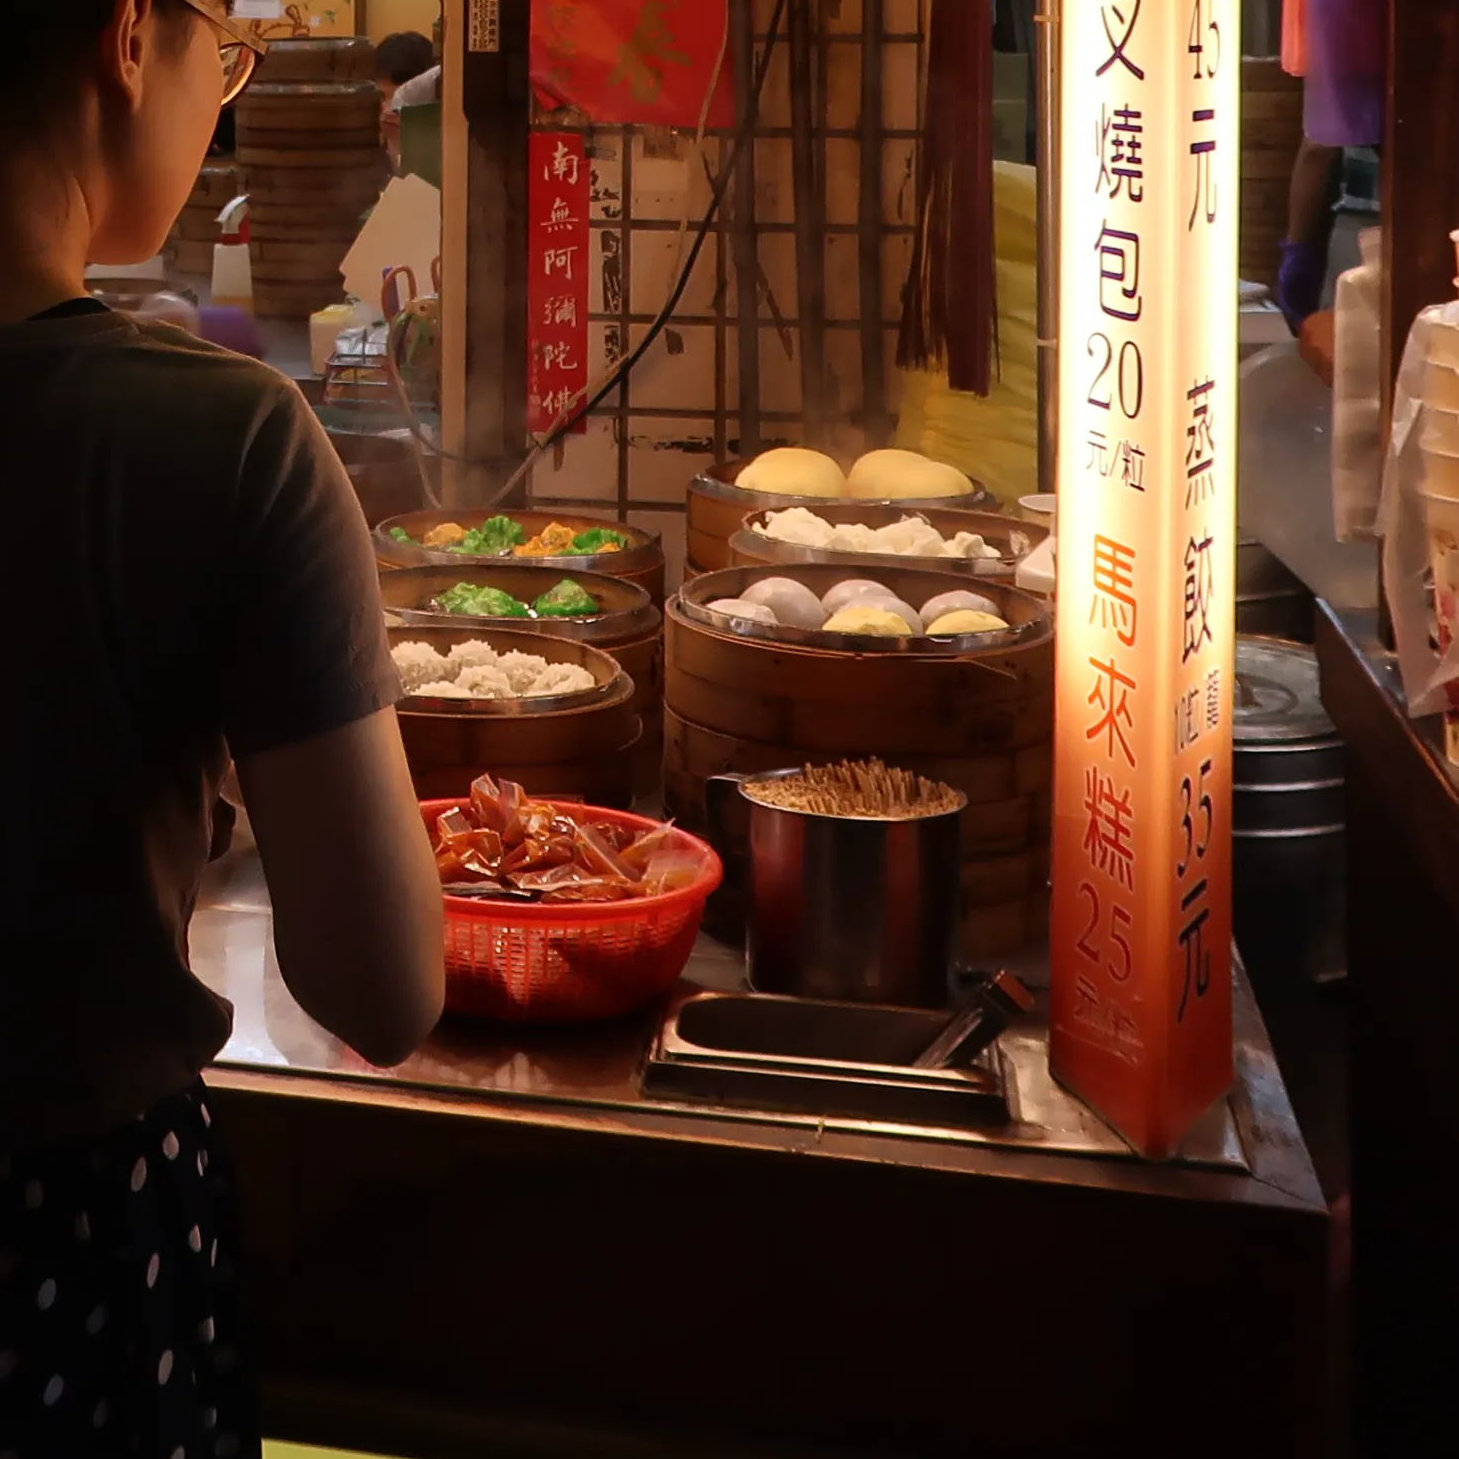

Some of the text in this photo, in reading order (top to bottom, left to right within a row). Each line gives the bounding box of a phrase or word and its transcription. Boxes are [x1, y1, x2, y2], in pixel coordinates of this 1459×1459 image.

[541, 141, 579, 423] 南無阿彌陀佛
[1087, 332, 1143, 420] 20
[1086, 429, 1146, 493] 元/粒
[1185, 375, 1215, 664] 蒸餃
[1084, 533, 1138, 892] 馬來糕
[1077, 882, 1133, 983] 25
